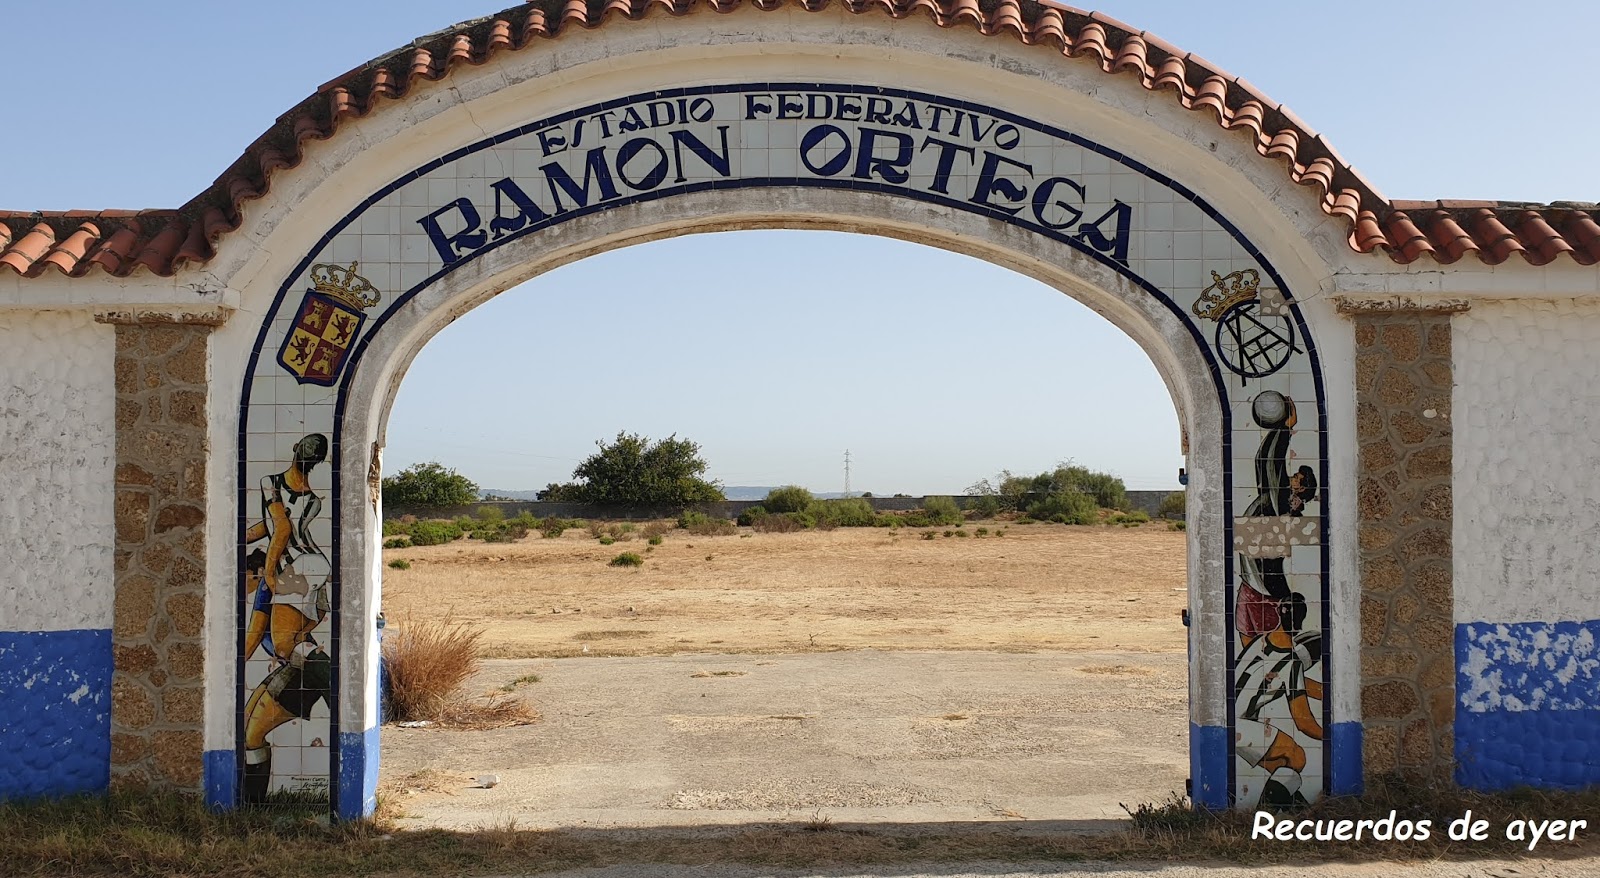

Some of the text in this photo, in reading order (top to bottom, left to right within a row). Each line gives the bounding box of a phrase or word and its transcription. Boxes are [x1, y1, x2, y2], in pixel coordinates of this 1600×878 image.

[536, 92, 1021, 157] ESTADIO FEDERATIVO
[416, 124, 1134, 269] RAMON ORTEGA
